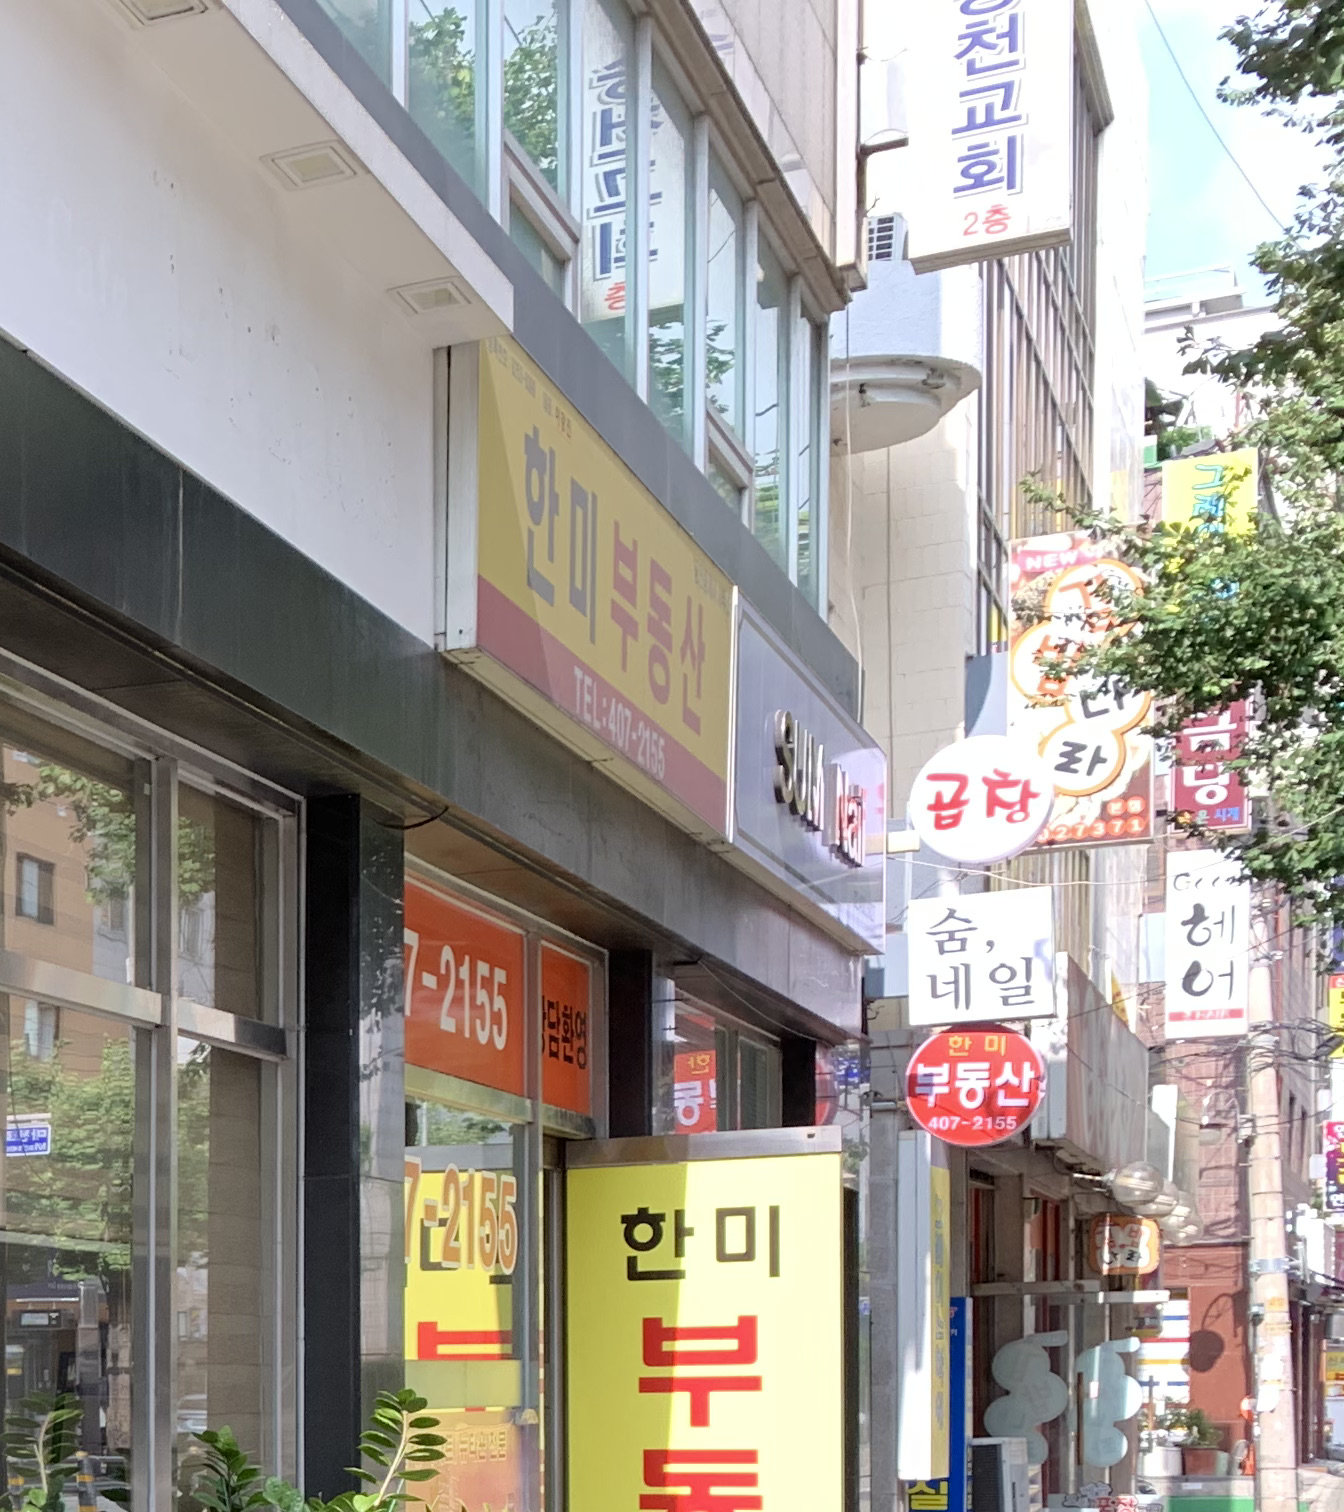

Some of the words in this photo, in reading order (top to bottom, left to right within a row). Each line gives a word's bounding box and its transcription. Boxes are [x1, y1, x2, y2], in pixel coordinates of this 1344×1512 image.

[962, 203, 1012, 237] 2층
[523, 424, 599, 645] 한미
[611, 520, 706, 736] 부동산
[1025, 551, 1079, 570] NEW
[925, 768, 1041, 831] 곱창
[925, 907, 995, 956] 숨,
[1180, 902, 1236, 1001] 헤어
[926, 956, 1036, 1011] 네일
[542, 994, 588, 1070] 담환영
[948, 1034, 1008, 1058] 한미
[914, 1062, 1037, 1109] 부동산
[928, 1115, 1018, 1131] 407-2155
[620, 1204, 780, 1282] 한미
